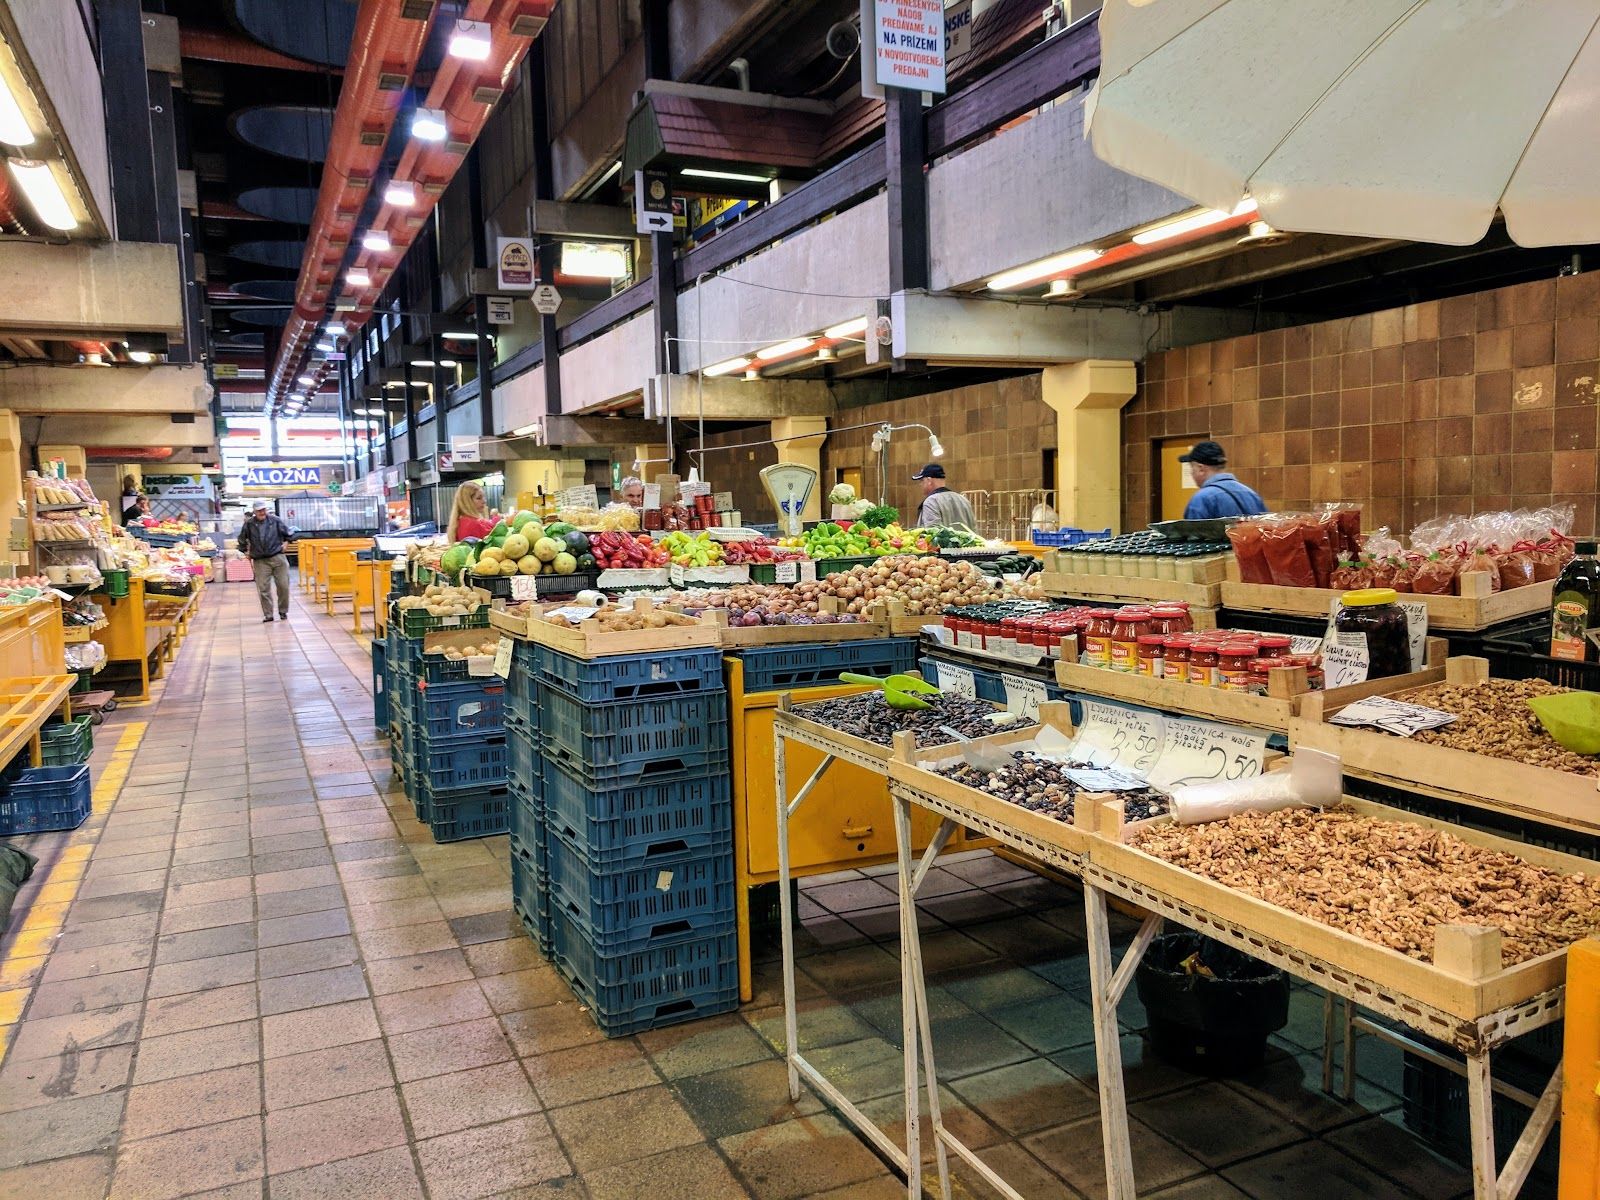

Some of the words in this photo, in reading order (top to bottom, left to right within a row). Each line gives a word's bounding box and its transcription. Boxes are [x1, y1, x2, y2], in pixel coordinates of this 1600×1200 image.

[928, 25, 938, 36] AJ
[883, 31, 897, 45] NA
[900, 34, 937, 52] PRÍZEMÍ
[877, 47, 883, 57] V
[1091, 703, 1137, 719] LJUTENICA
